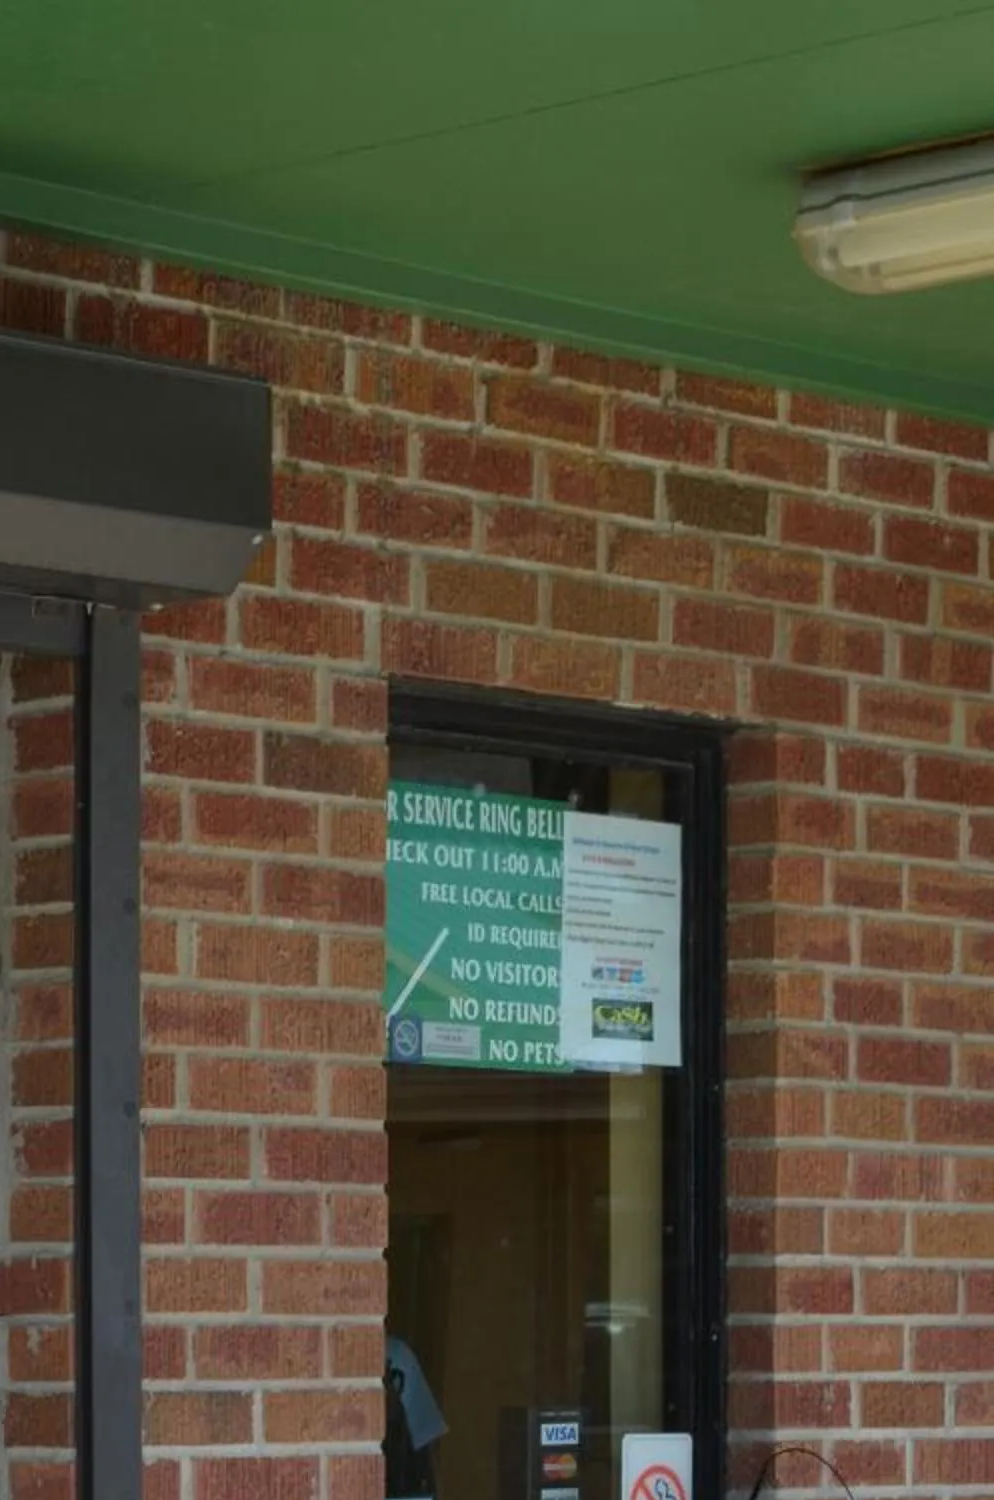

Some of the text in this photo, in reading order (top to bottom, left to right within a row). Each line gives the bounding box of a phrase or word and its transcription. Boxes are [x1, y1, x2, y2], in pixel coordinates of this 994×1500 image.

[386, 789, 564, 840] R SERVICE RING BELL
[433, 844, 475, 870] OUT
[481, 851, 529, 876] 11:00
[421, 881, 458, 904] FREE
[462, 886, 515, 910] LOCAL
[467, 922, 485, 943] ID
[450, 956, 481, 982] NO
[484, 960, 560, 989] VISITOR
[449, 996, 561, 1026] NO REFUND
[489, 1039, 519, 1062] NO
[545, 1427, 577, 1441] VISA
